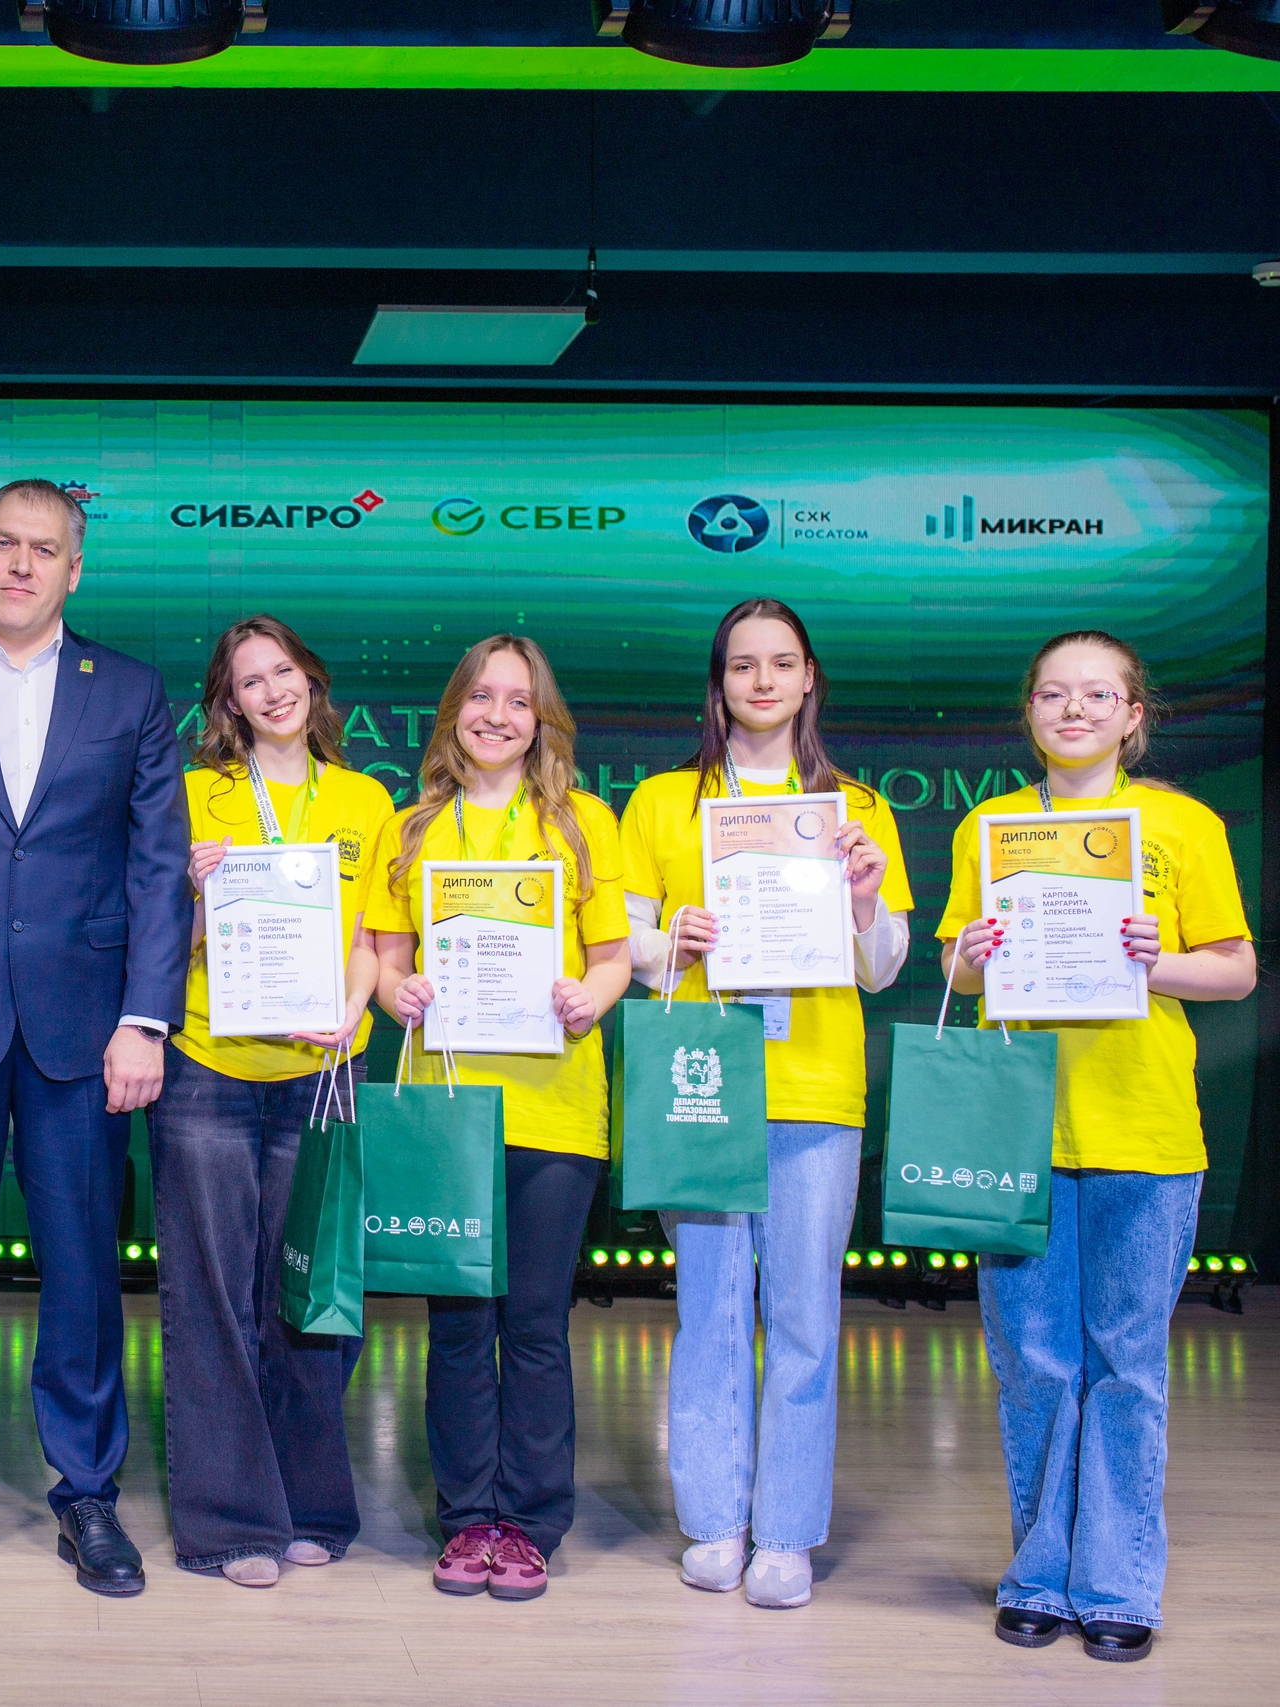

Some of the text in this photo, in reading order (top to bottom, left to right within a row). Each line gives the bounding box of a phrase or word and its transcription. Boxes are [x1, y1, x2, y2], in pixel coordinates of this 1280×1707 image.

[170, 504, 363, 529] СИБАГРО
[500, 506, 627, 531] СБЕР
[794, 510, 831, 523] СХК
[981, 518, 1103, 535] МИКРАН
[794, 529, 869, 539] РОСАТОМ
[720, 814, 771, 827] ДИПЛОМ
[1001, 830, 1058, 844] ДИПЛОМ
[222, 862, 271, 874] ДИПЛОМ
[443, 878, 492, 889] ДИПЛОМ
[1042, 891, 1078, 899] КАРПОВА
[1043, 908, 1092, 916] АЛЕКСЕЕВНА
[673, 1098, 721, 1106] ДЕПАРТАМЕНТ
[673, 1106, 721, 1114] ОБРАЗОВАНИЯ
[666, 1114, 729, 1123] ТОМСКОЙ ОБЛАСТИ
